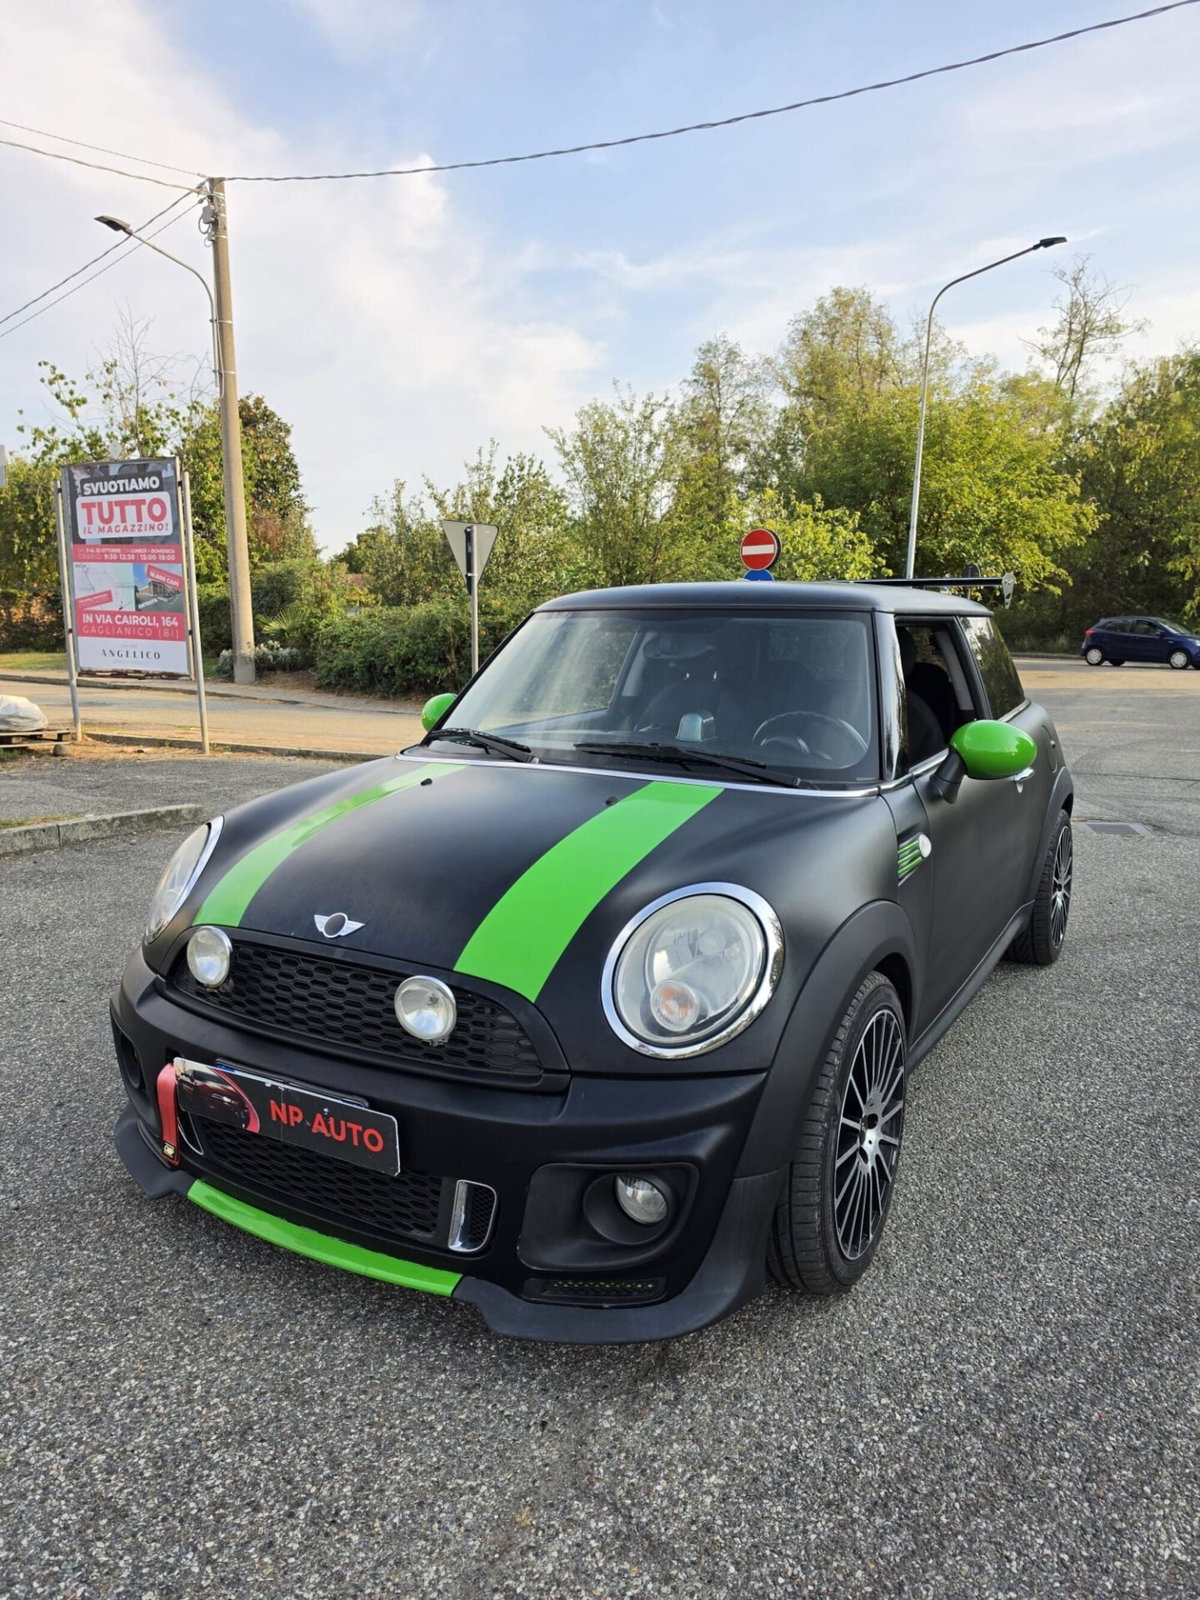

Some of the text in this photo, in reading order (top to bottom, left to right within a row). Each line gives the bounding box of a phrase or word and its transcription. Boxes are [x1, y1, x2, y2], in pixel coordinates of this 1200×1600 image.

[83, 476, 160, 495] SVUOTIAMO
[81, 497, 167, 525] TUTTO
[83, 523, 169, 534] IL MAGAZZINO!
[82, 613, 179, 627] IN VIA CAIROLI, 164
[83, 625, 179, 639] GAGLIANICO (BI)
[269, 1100, 385, 1152] NP AUTO
